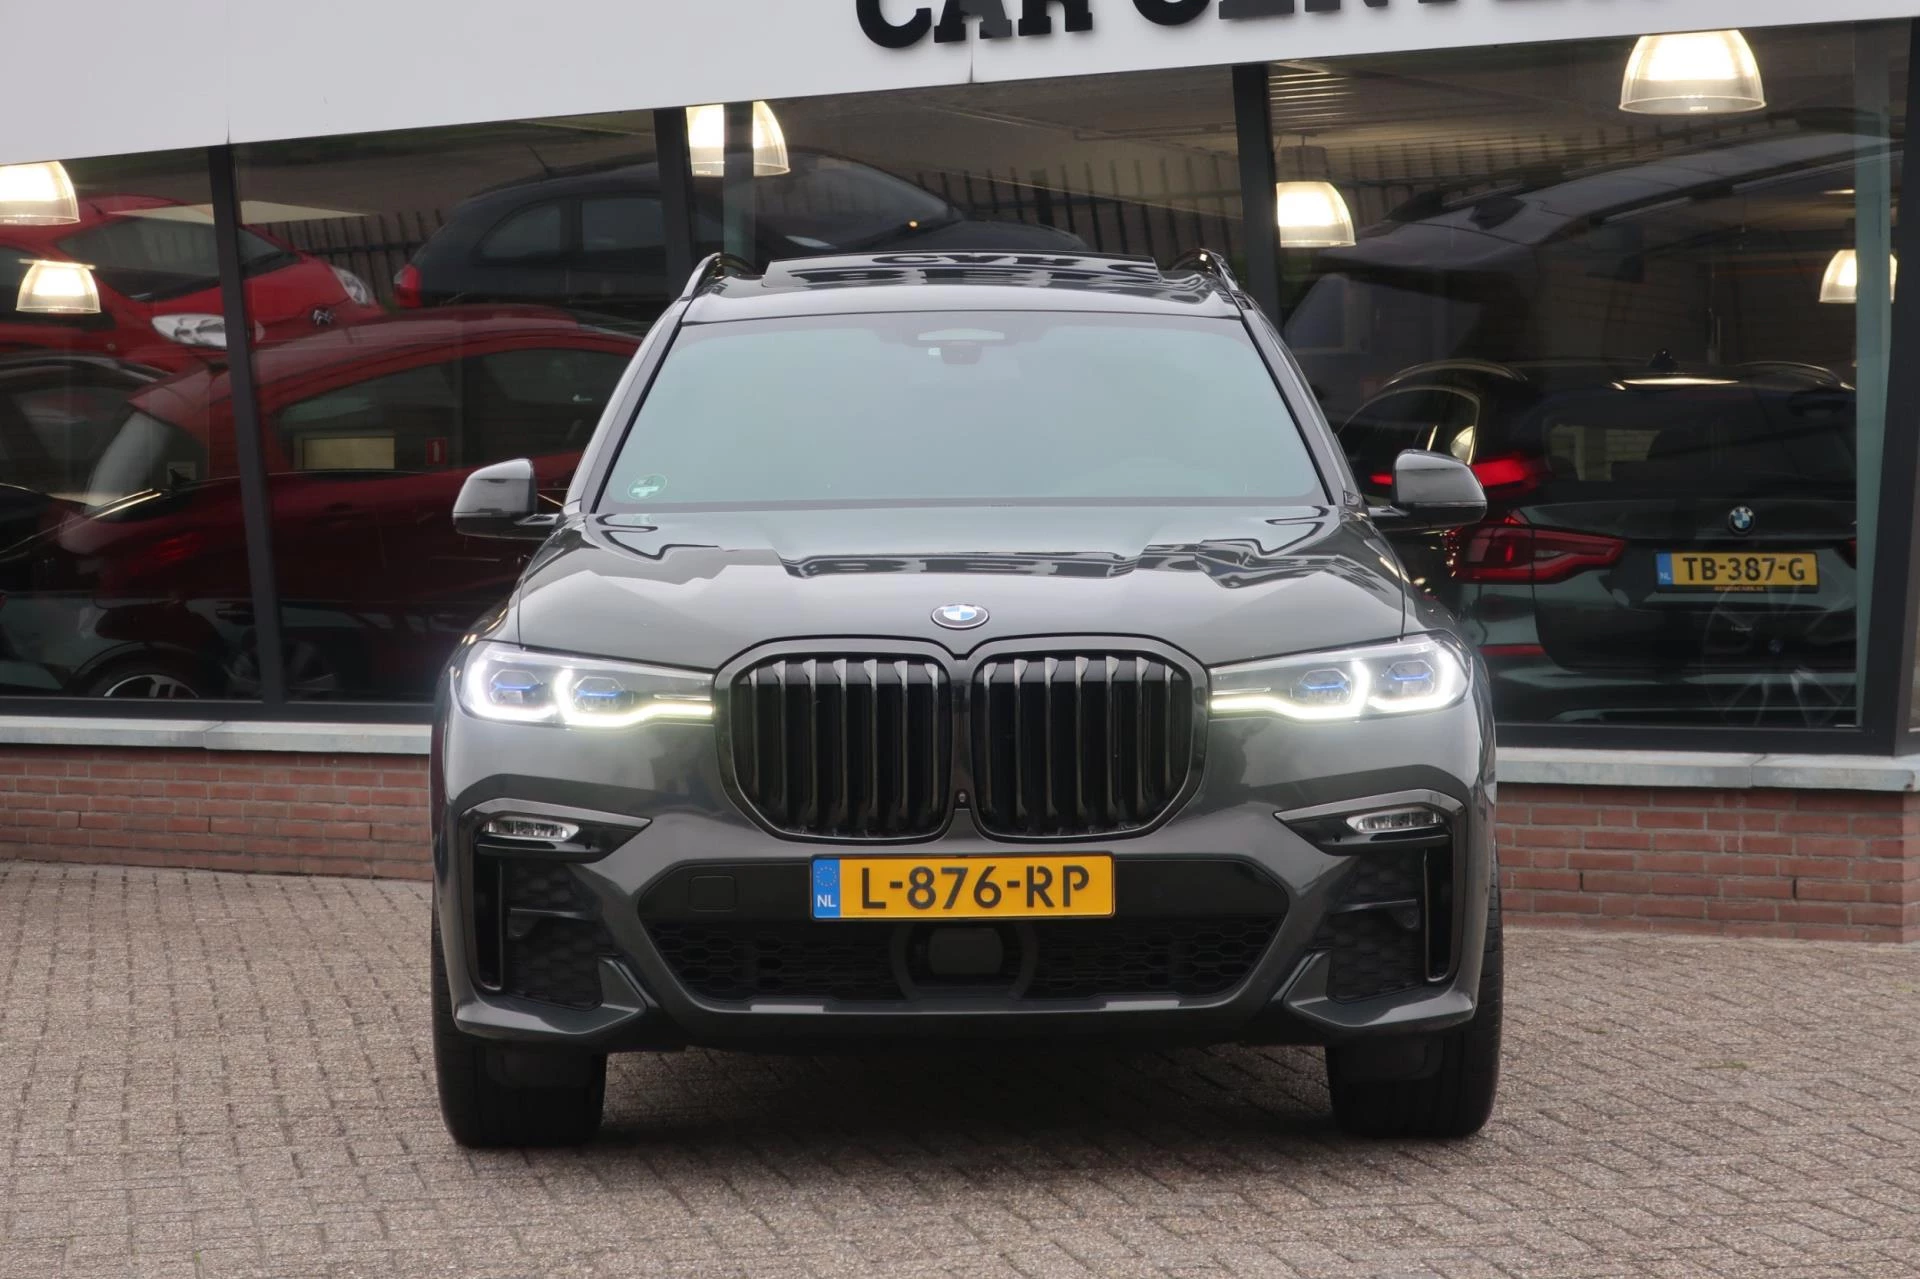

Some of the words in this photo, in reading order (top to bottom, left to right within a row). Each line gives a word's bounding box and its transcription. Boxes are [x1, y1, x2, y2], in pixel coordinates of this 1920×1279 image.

[1682, 557, 1805, 581] TB-387-G
[862, 865, 1090, 909] L-876-RP
[817, 895, 837, 908] NL
